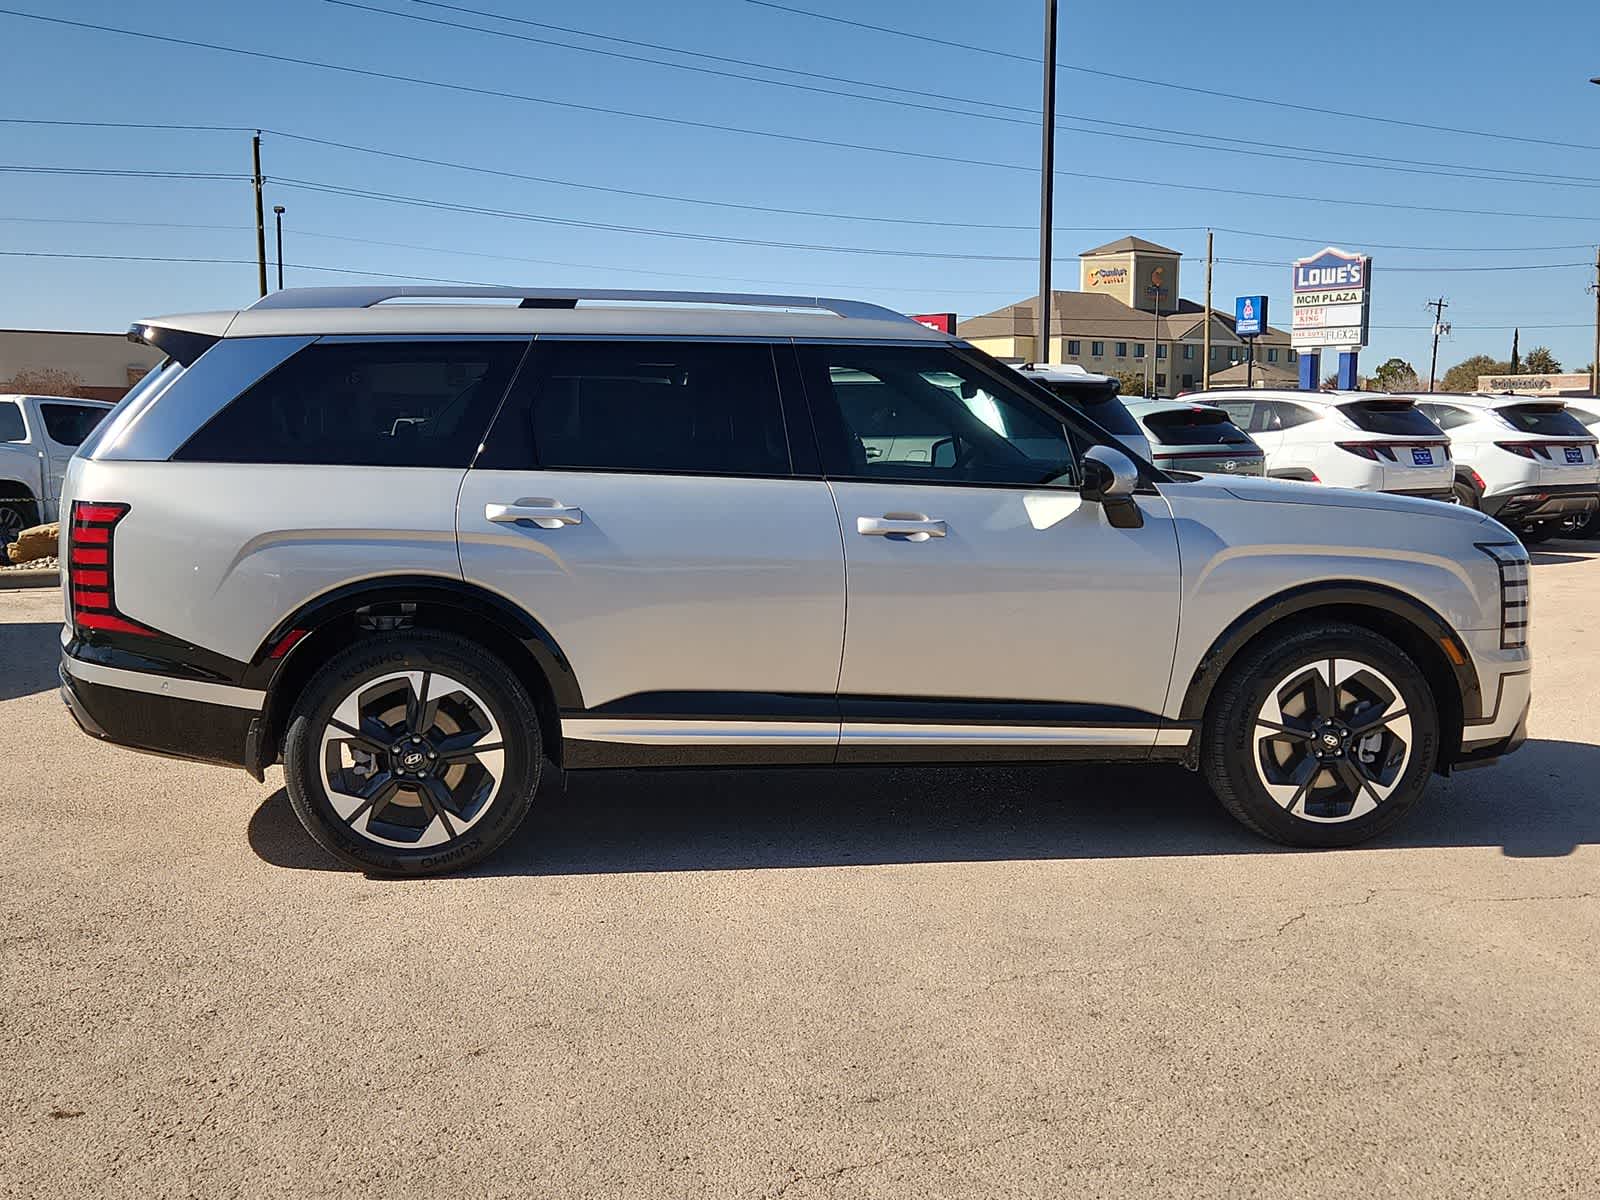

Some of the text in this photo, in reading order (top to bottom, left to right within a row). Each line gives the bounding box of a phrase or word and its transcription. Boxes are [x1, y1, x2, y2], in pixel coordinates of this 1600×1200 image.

[1298, 264, 1360, 286] LOWE'S
[1296, 292, 1357, 304] MCM PLAZA
[1295, 308, 1323, 316] BUFFET
